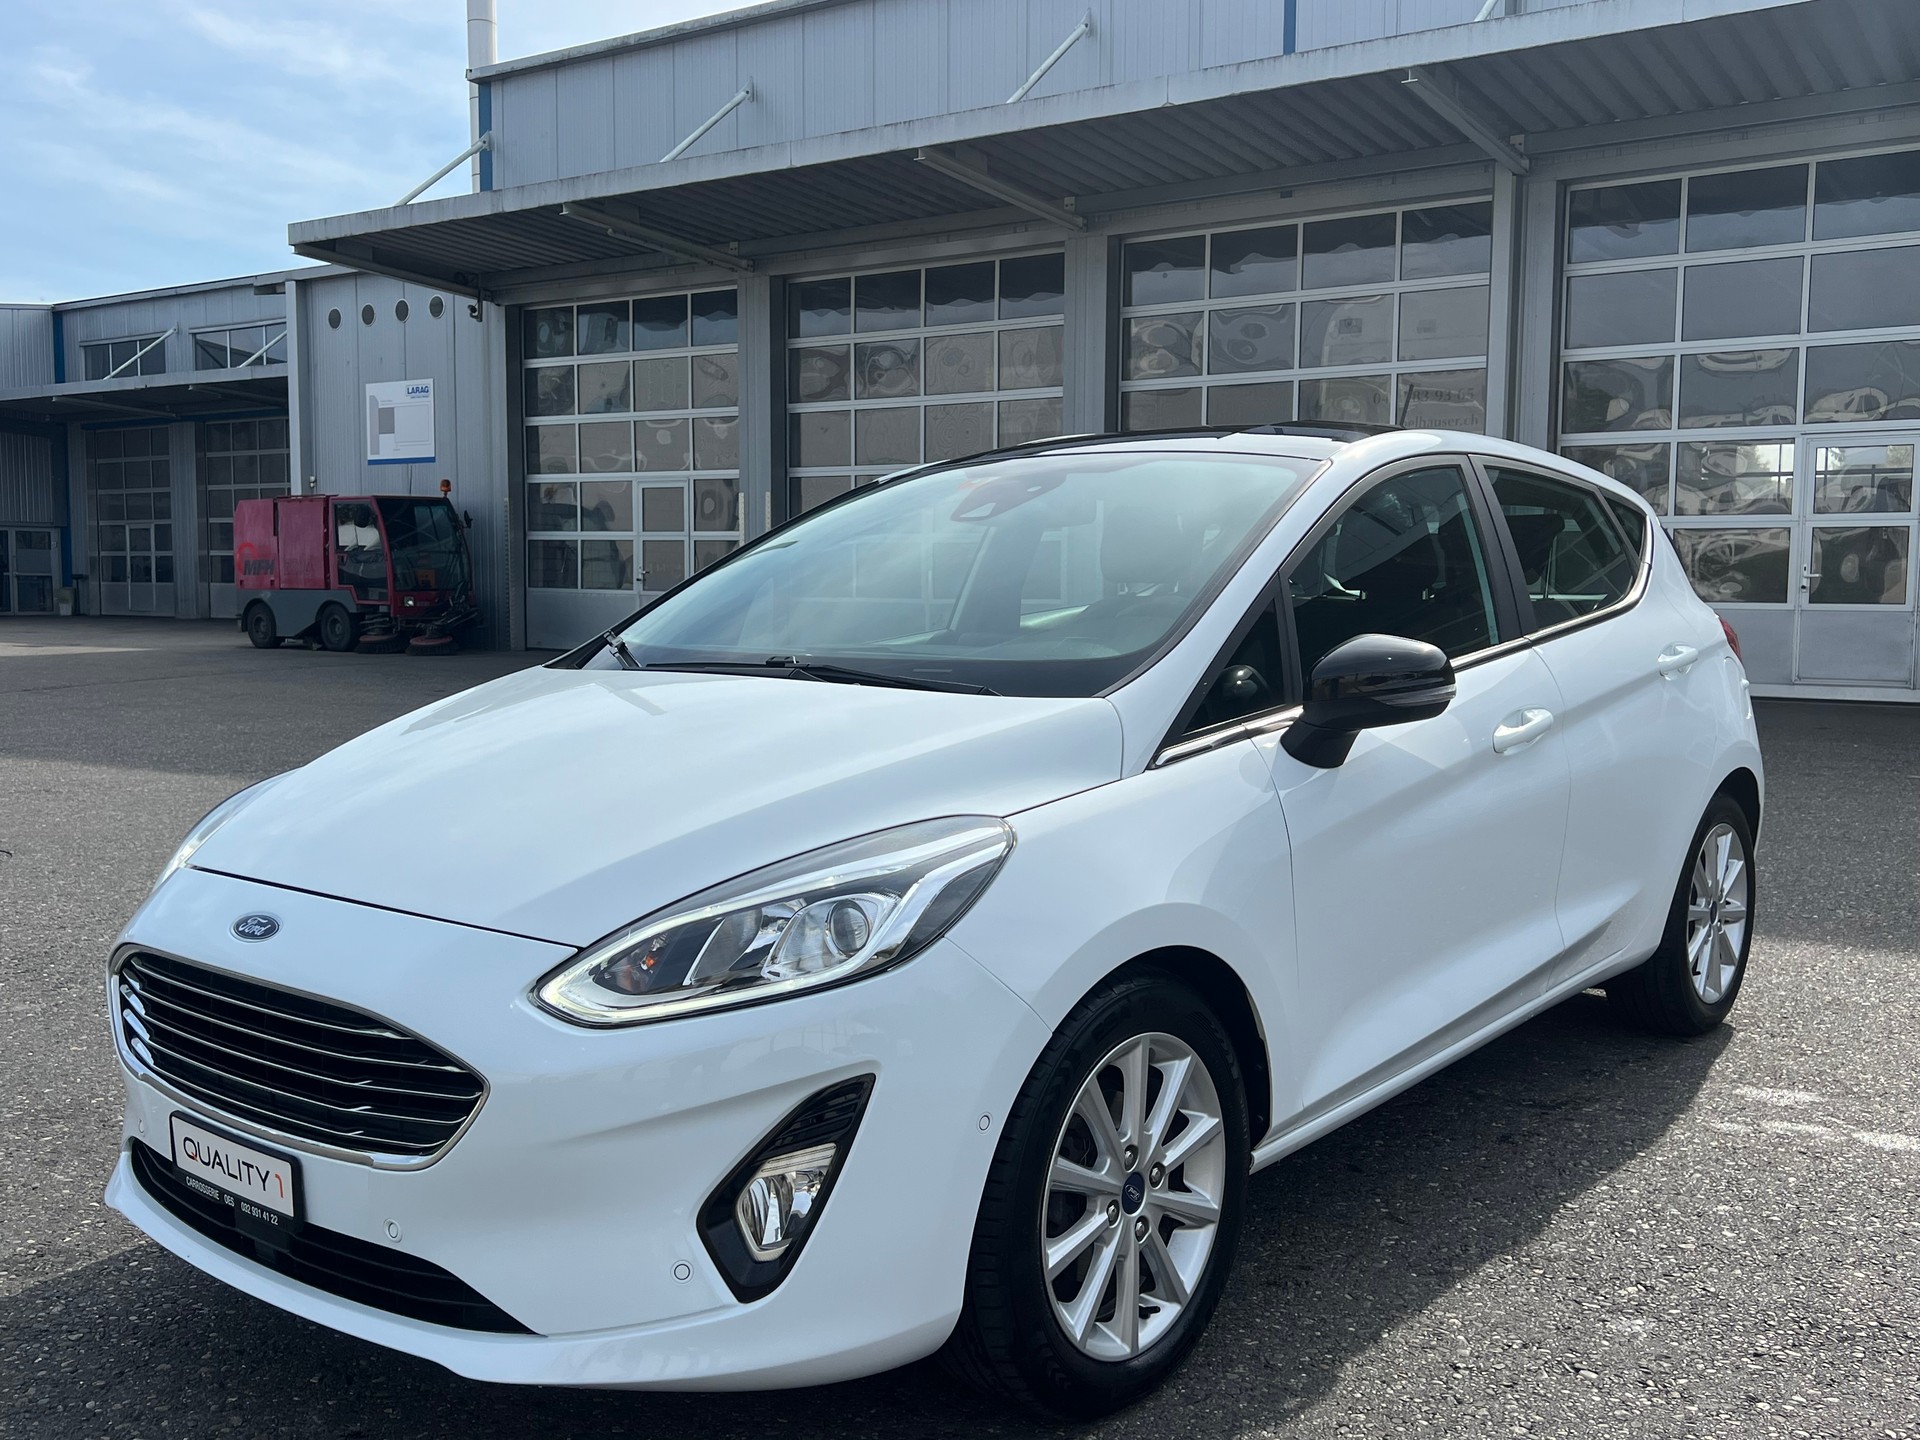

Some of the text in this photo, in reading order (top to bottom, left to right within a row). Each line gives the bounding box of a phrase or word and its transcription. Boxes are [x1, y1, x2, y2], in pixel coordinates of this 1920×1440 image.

[406, 385, 429, 395] LARAG
[238, 916, 272, 936] Ford
[183, 1136, 283, 1198] QUALITY 1
[185, 1176, 279, 1225] CARROSSERIE OES 032 931 41 22
